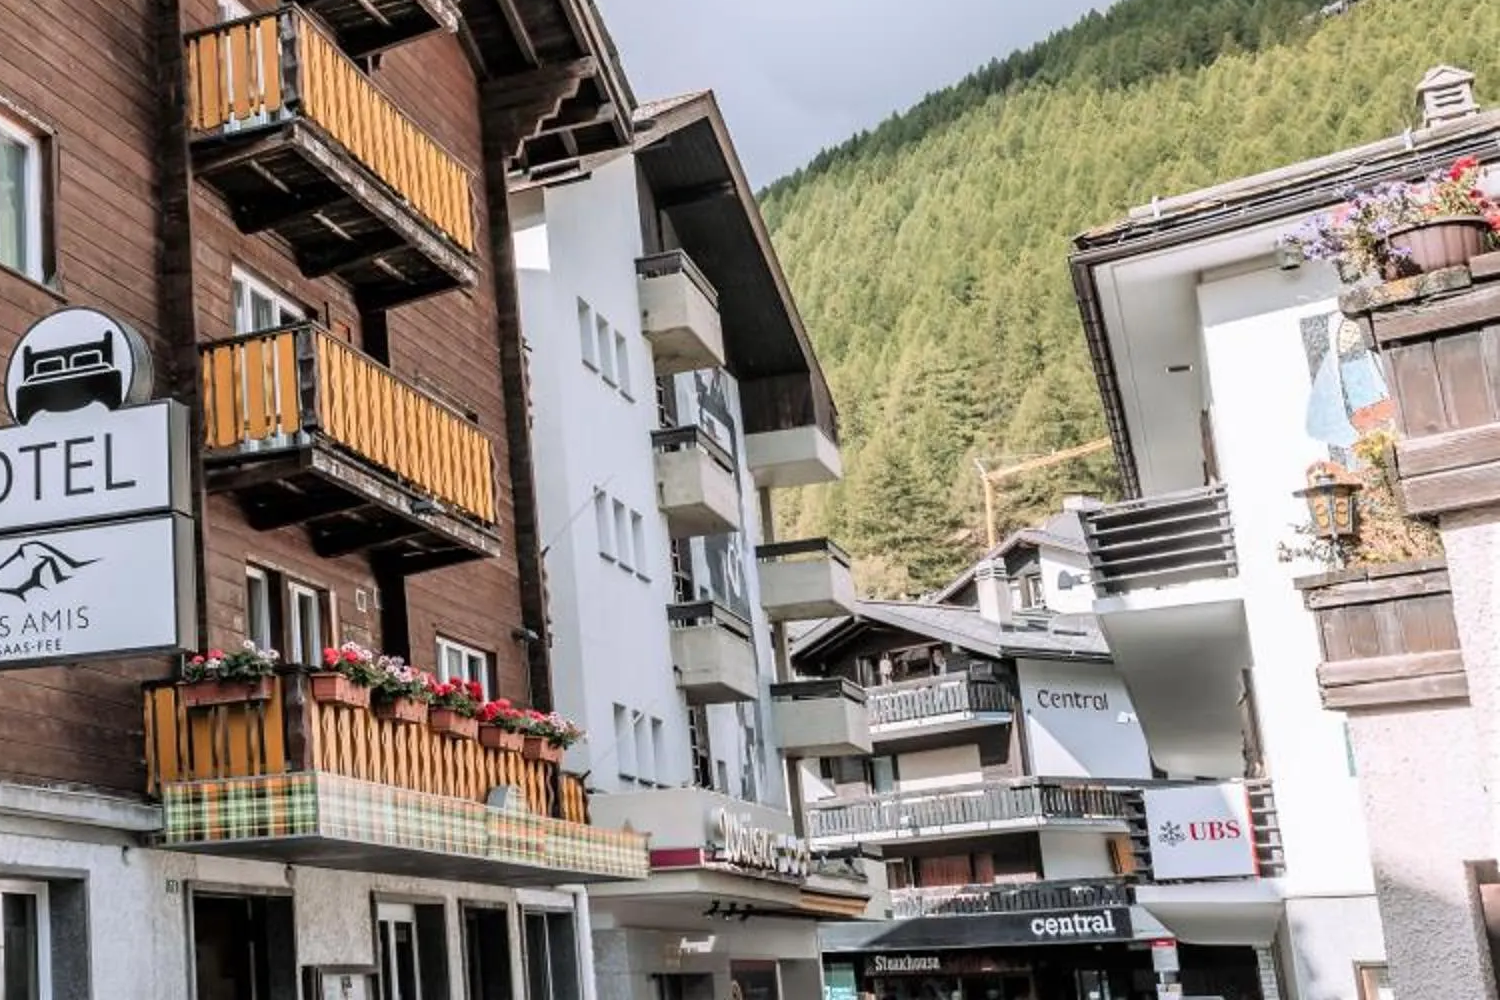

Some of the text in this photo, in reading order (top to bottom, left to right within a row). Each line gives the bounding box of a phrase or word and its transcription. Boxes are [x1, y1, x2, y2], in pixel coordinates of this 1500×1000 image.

[20, 606, 89, 635] AMIS
[1037, 689, 1109, 711] Central
[1189, 820, 1241, 841] UBS
[1031, 910, 1116, 935] central
